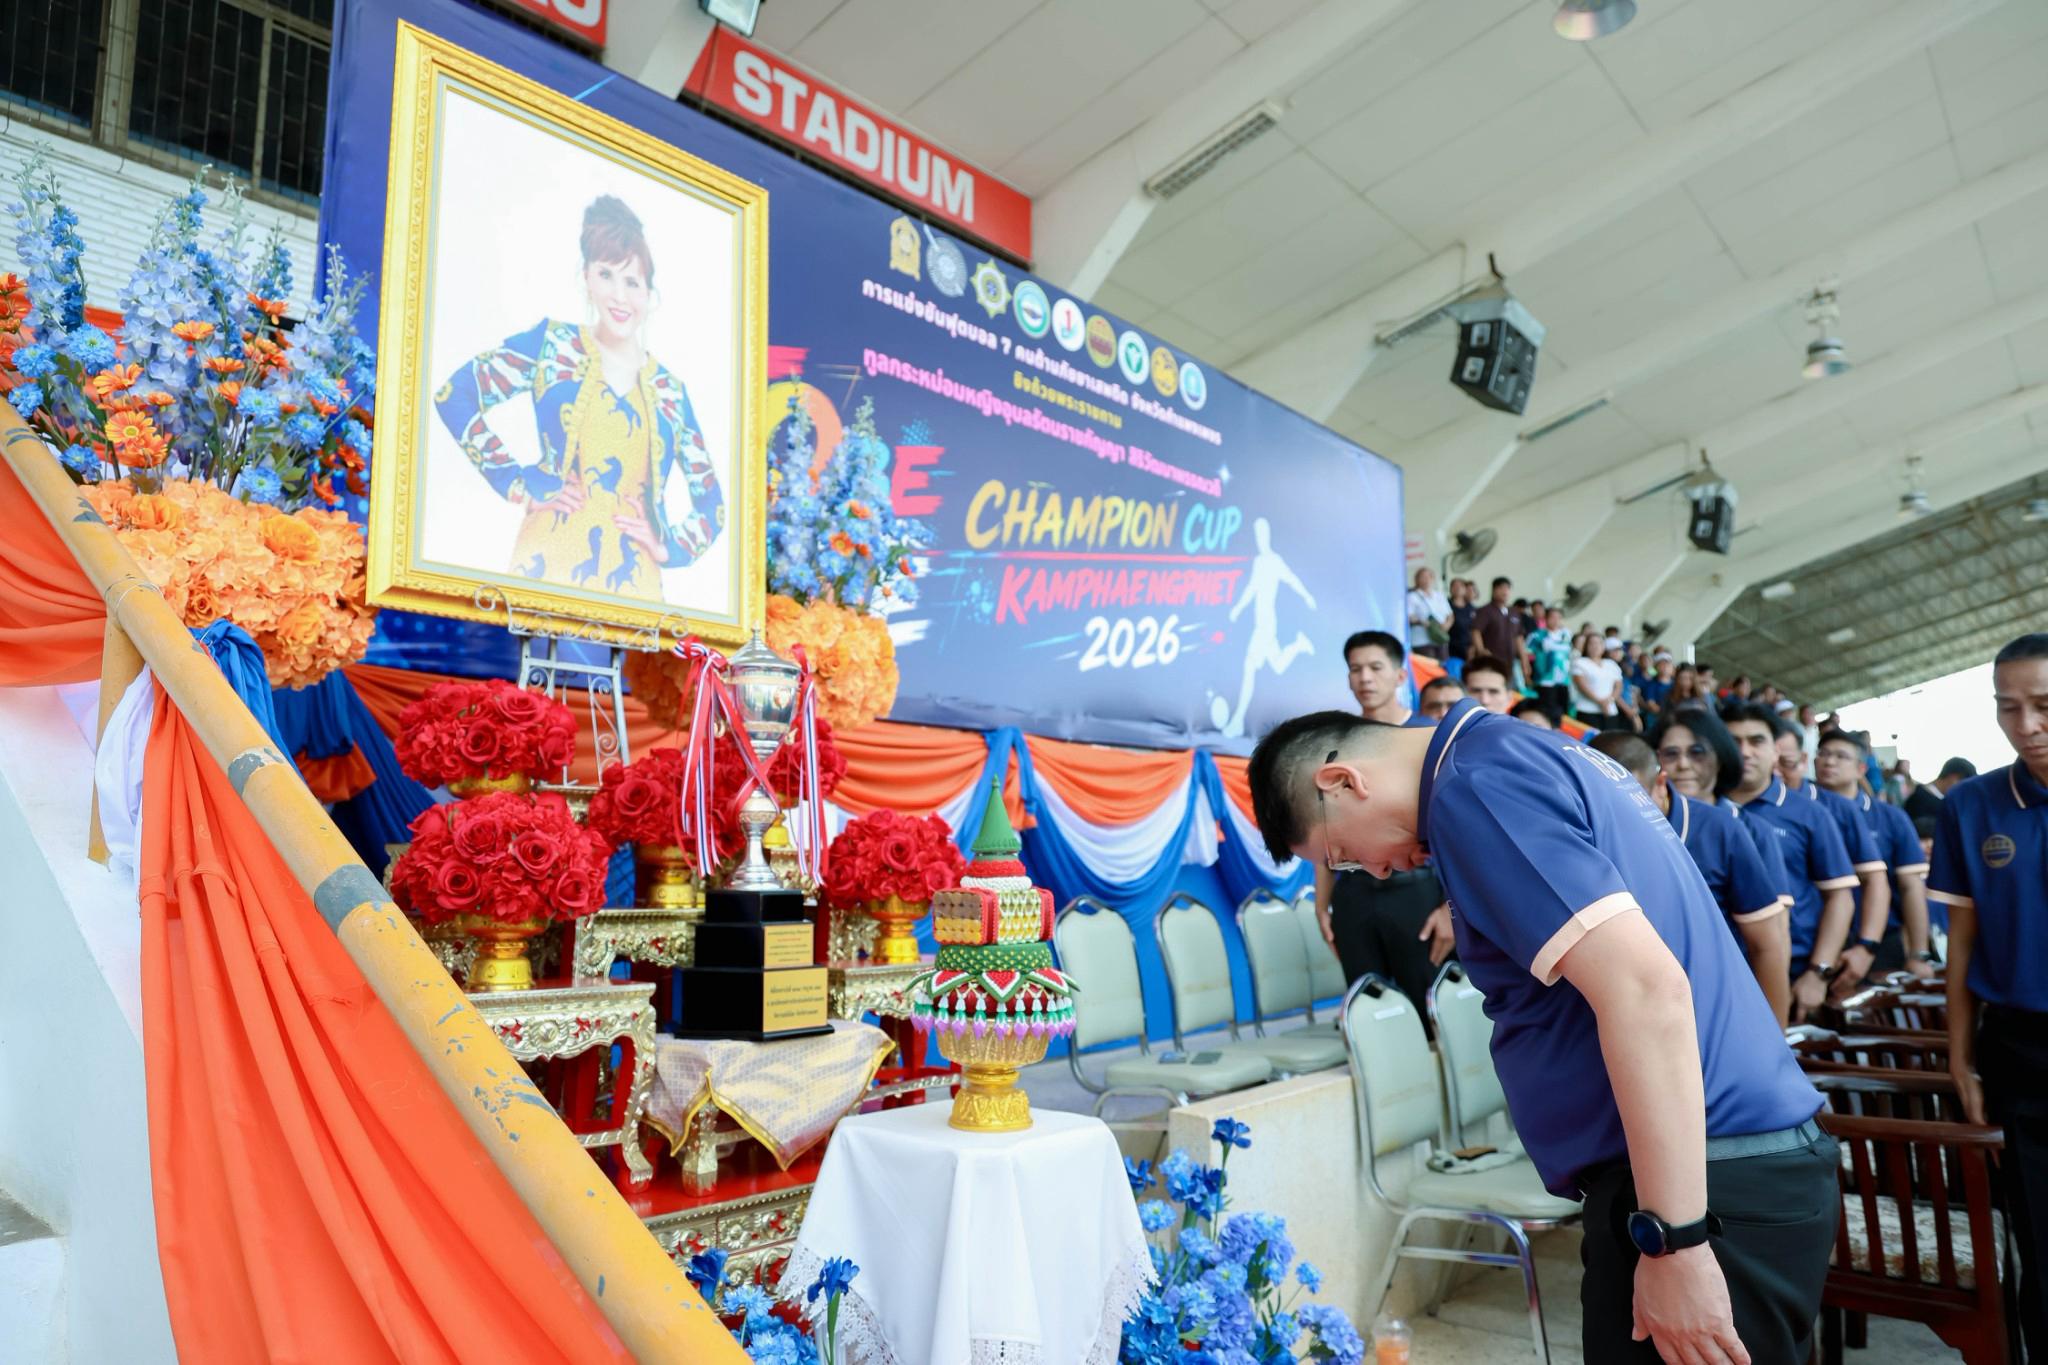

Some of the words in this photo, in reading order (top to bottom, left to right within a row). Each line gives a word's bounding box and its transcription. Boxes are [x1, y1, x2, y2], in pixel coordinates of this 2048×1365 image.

[731, 50, 975, 223] STADIUM
[1001, 336, 1012, 355] 7
[965, 479, 1179, 551] CHAMPION
[1182, 502, 1242, 554] CUP
[995, 563, 1244, 625] KAMPHAENGPHET
[1078, 613, 1181, 672] 2026
